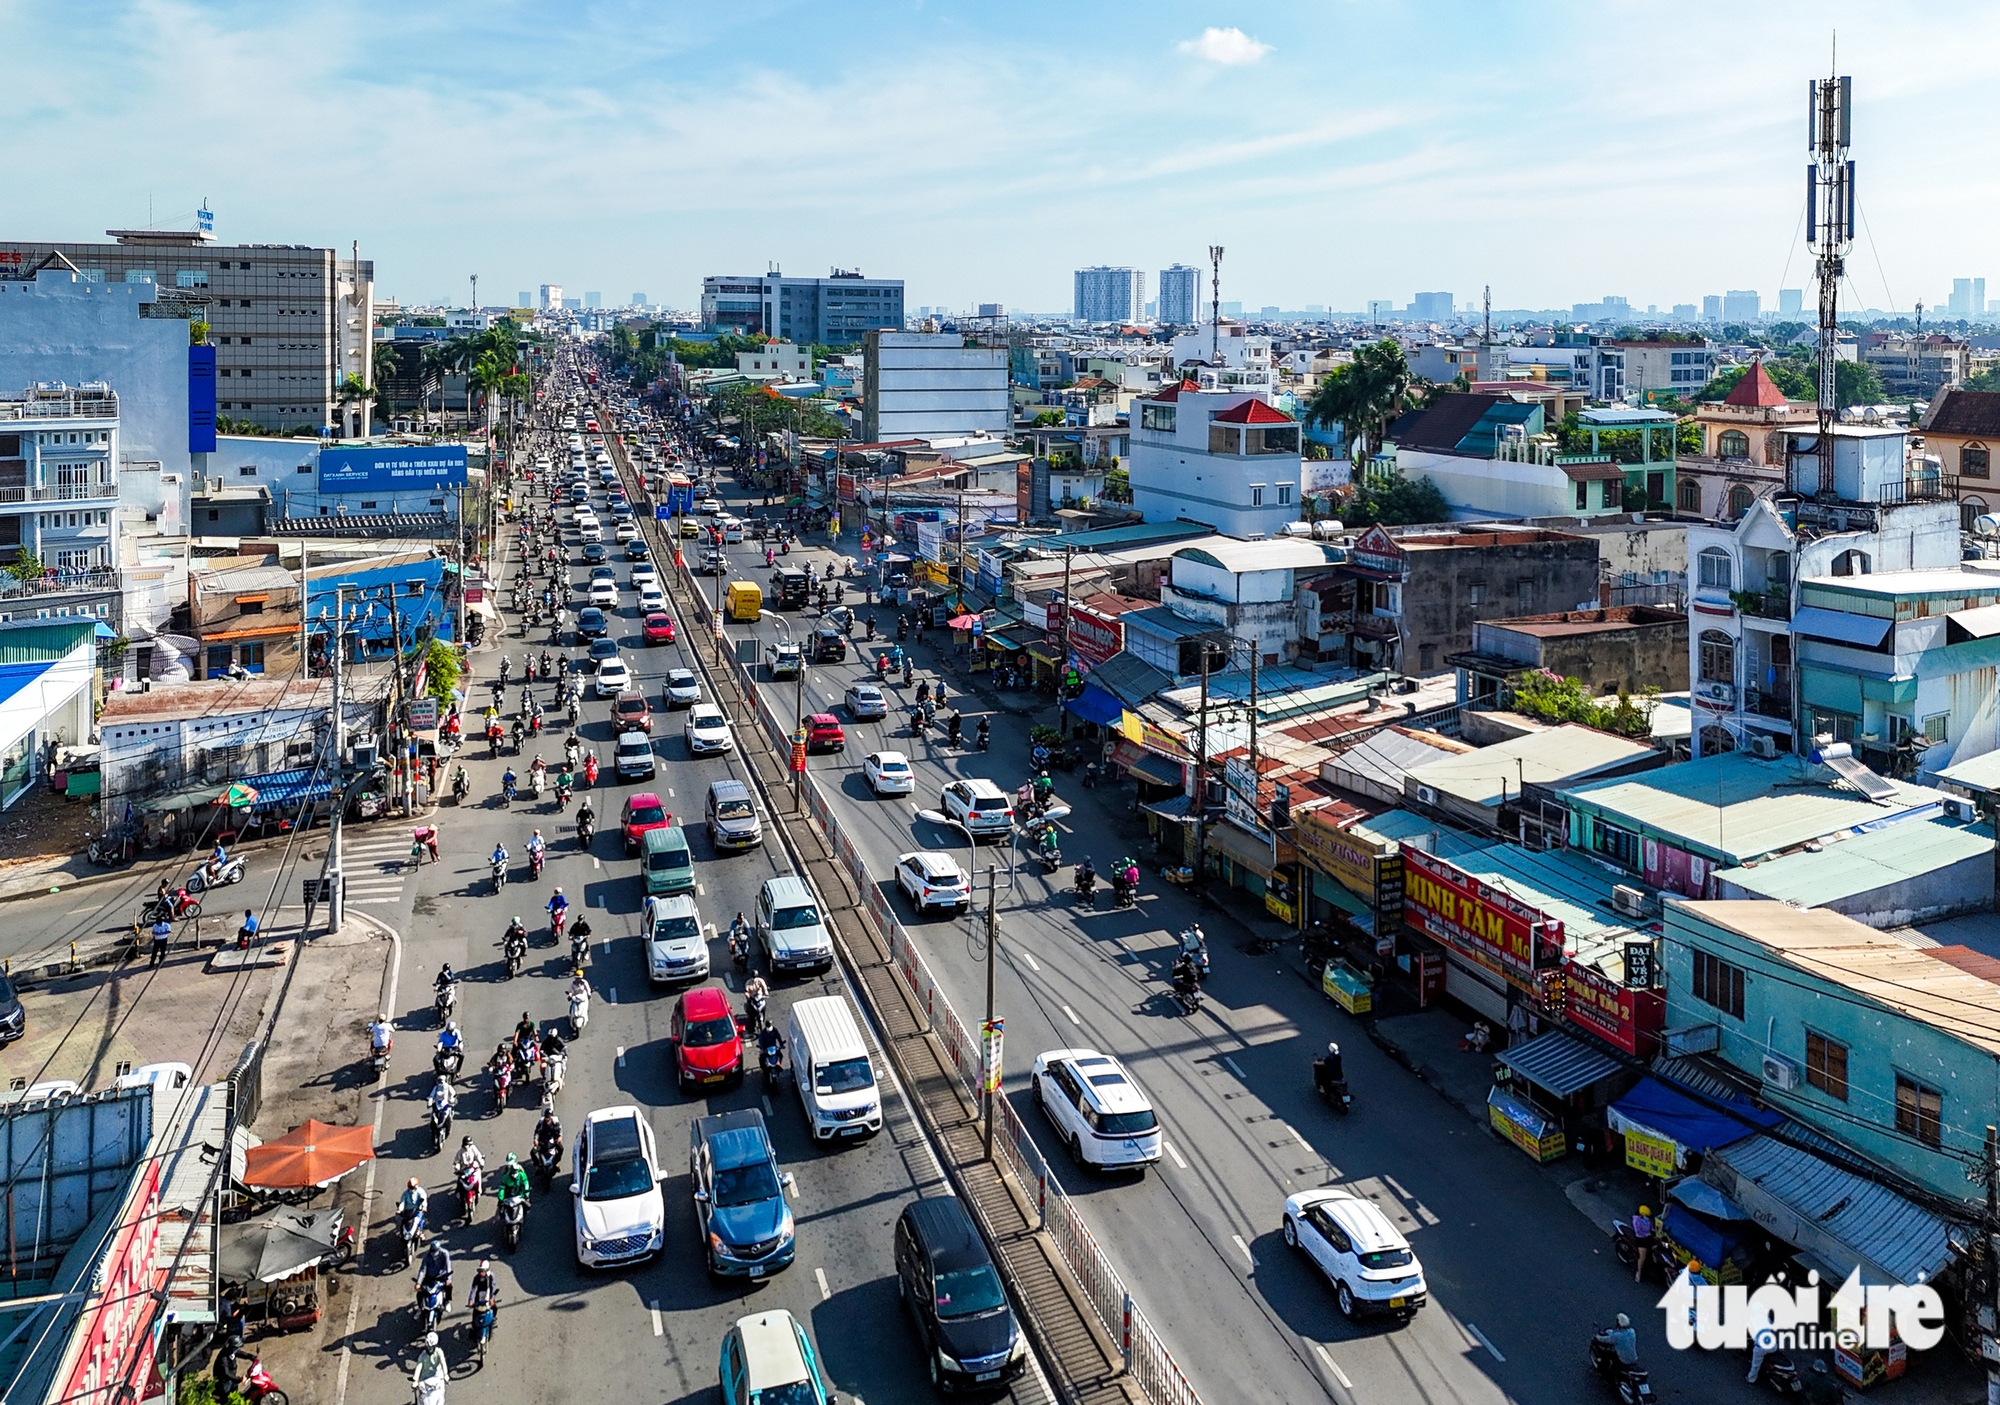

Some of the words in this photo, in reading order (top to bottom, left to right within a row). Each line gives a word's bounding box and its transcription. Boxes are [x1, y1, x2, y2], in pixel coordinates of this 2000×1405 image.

[1405, 869, 1457, 921] MINH
[1459, 897, 1505, 947] TÂM
[1629, 946, 1650, 958] ĐẠI
[1632, 954, 1647, 966] LÝ
[1631, 974, 1648, 986] SỐ
[1566, 975, 1597, 1003] PHÁT
[1598, 992, 1619, 1016] TÀI
[1621, 1005, 1630, 1021] 2
